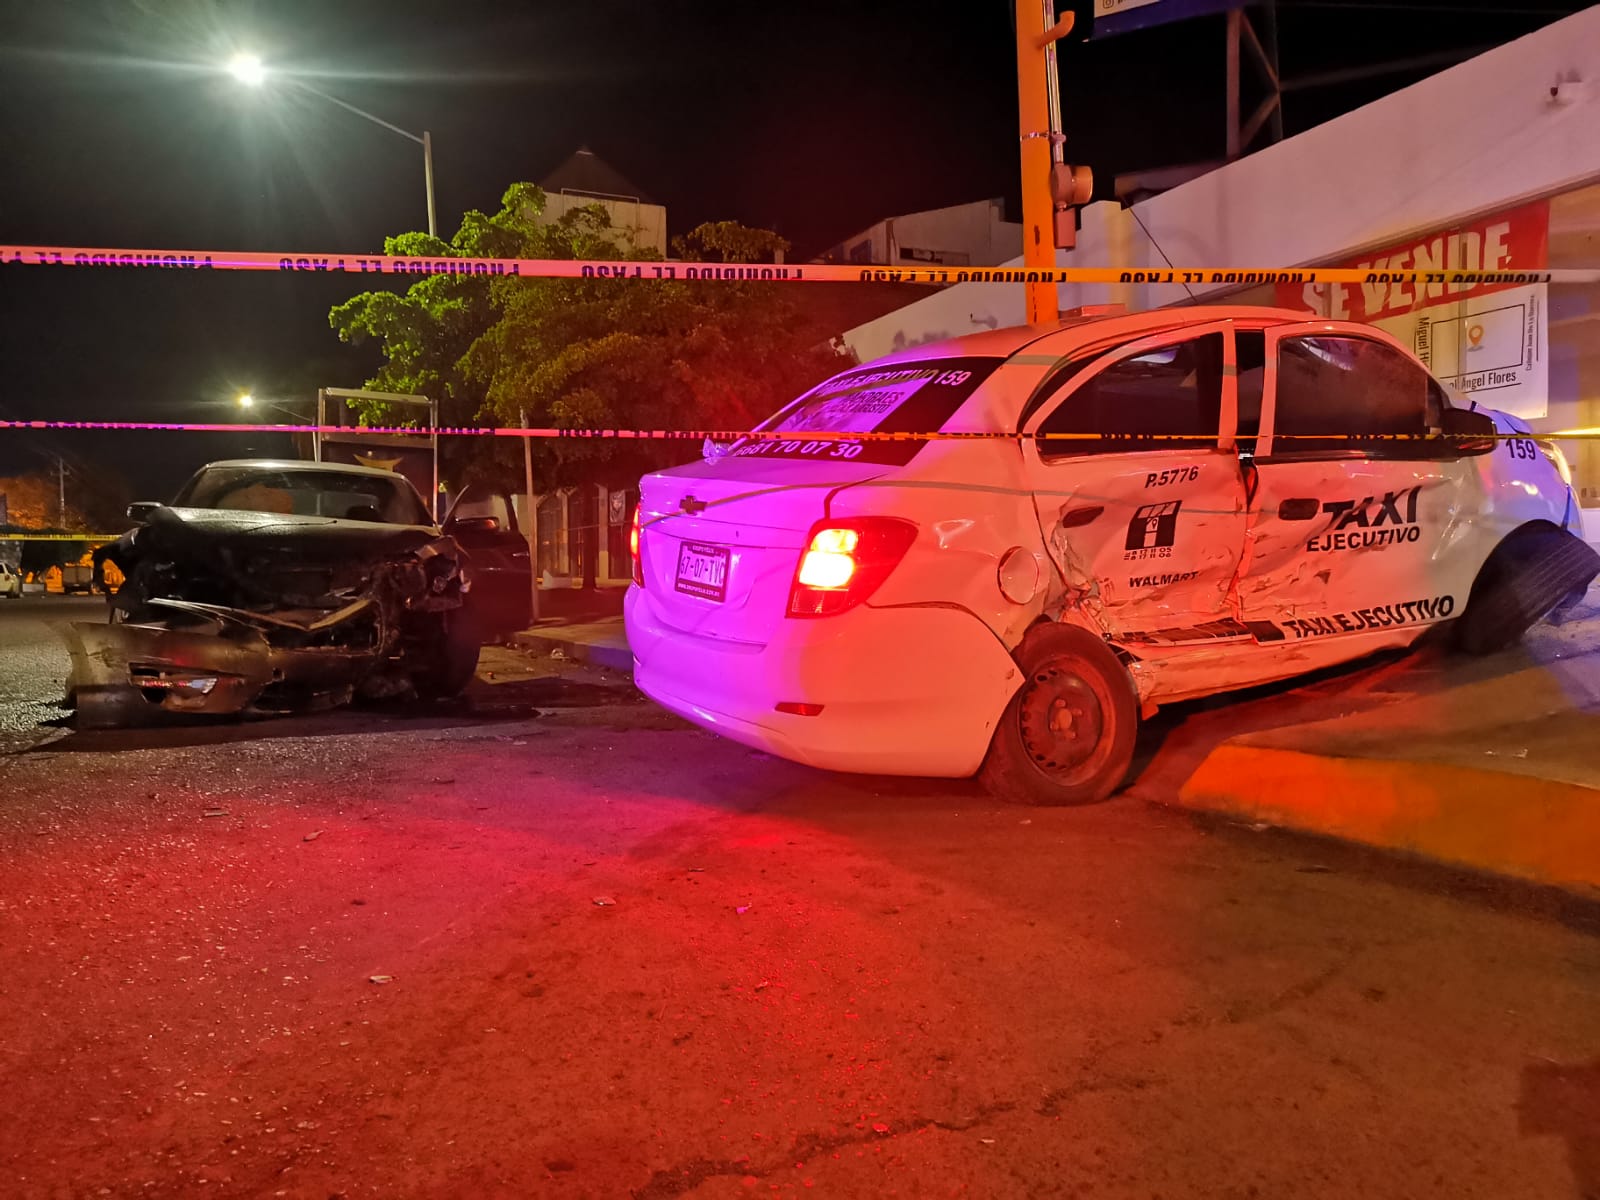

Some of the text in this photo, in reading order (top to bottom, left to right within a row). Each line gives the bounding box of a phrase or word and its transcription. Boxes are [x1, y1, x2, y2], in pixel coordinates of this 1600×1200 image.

[1357, 222, 1513, 318] VENDE
[1417, 317, 1430, 350] Miguel
[933, 370, 972, 386] 159
[1488, 371, 1517, 386] Flores
[773, 441, 802, 453] 70
[800, 441, 833, 454] 07
[829, 443, 863, 458] 30
[1506, 437, 1536, 460] 159
[1144, 465, 1200, 489] P.5776
[1322, 485, 1422, 530] TAXI
[1306, 526, 1421, 552] EJECUTIVO
[1129, 571, 1200, 588] WALMART
[1281, 595, 1455, 639] TAXI EJECUTIVO
